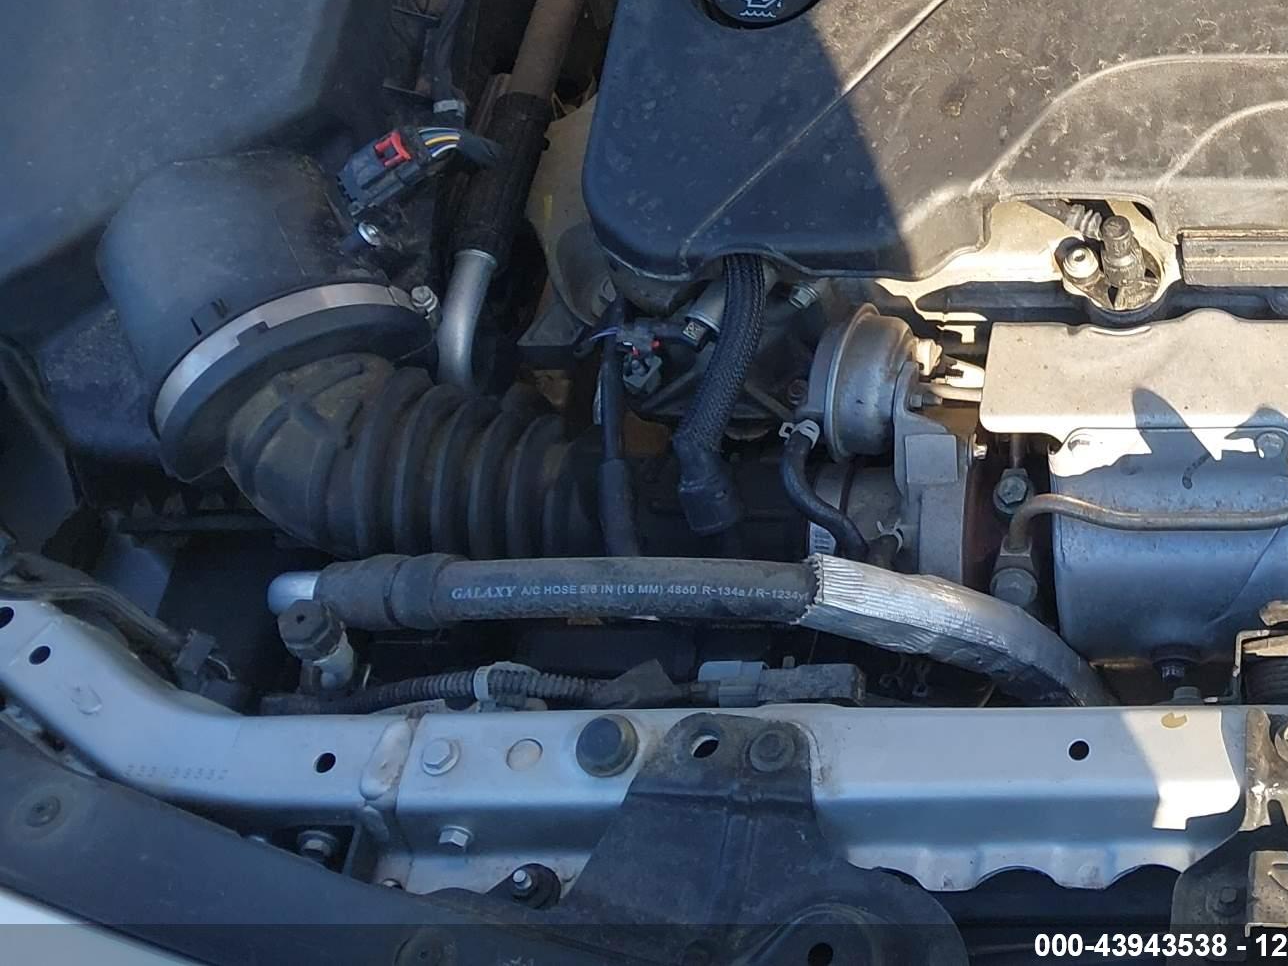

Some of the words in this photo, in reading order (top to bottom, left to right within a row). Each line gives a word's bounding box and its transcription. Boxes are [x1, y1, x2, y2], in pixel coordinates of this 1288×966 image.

[451, 585, 517, 600] GALAXY
[520, 585, 541, 596] A/C
[543, 585, 577, 595] HOSE
[601, 584, 614, 595] IN
[638, 585, 664, 595] MM)
[702, 585, 745, 597] R-134a
